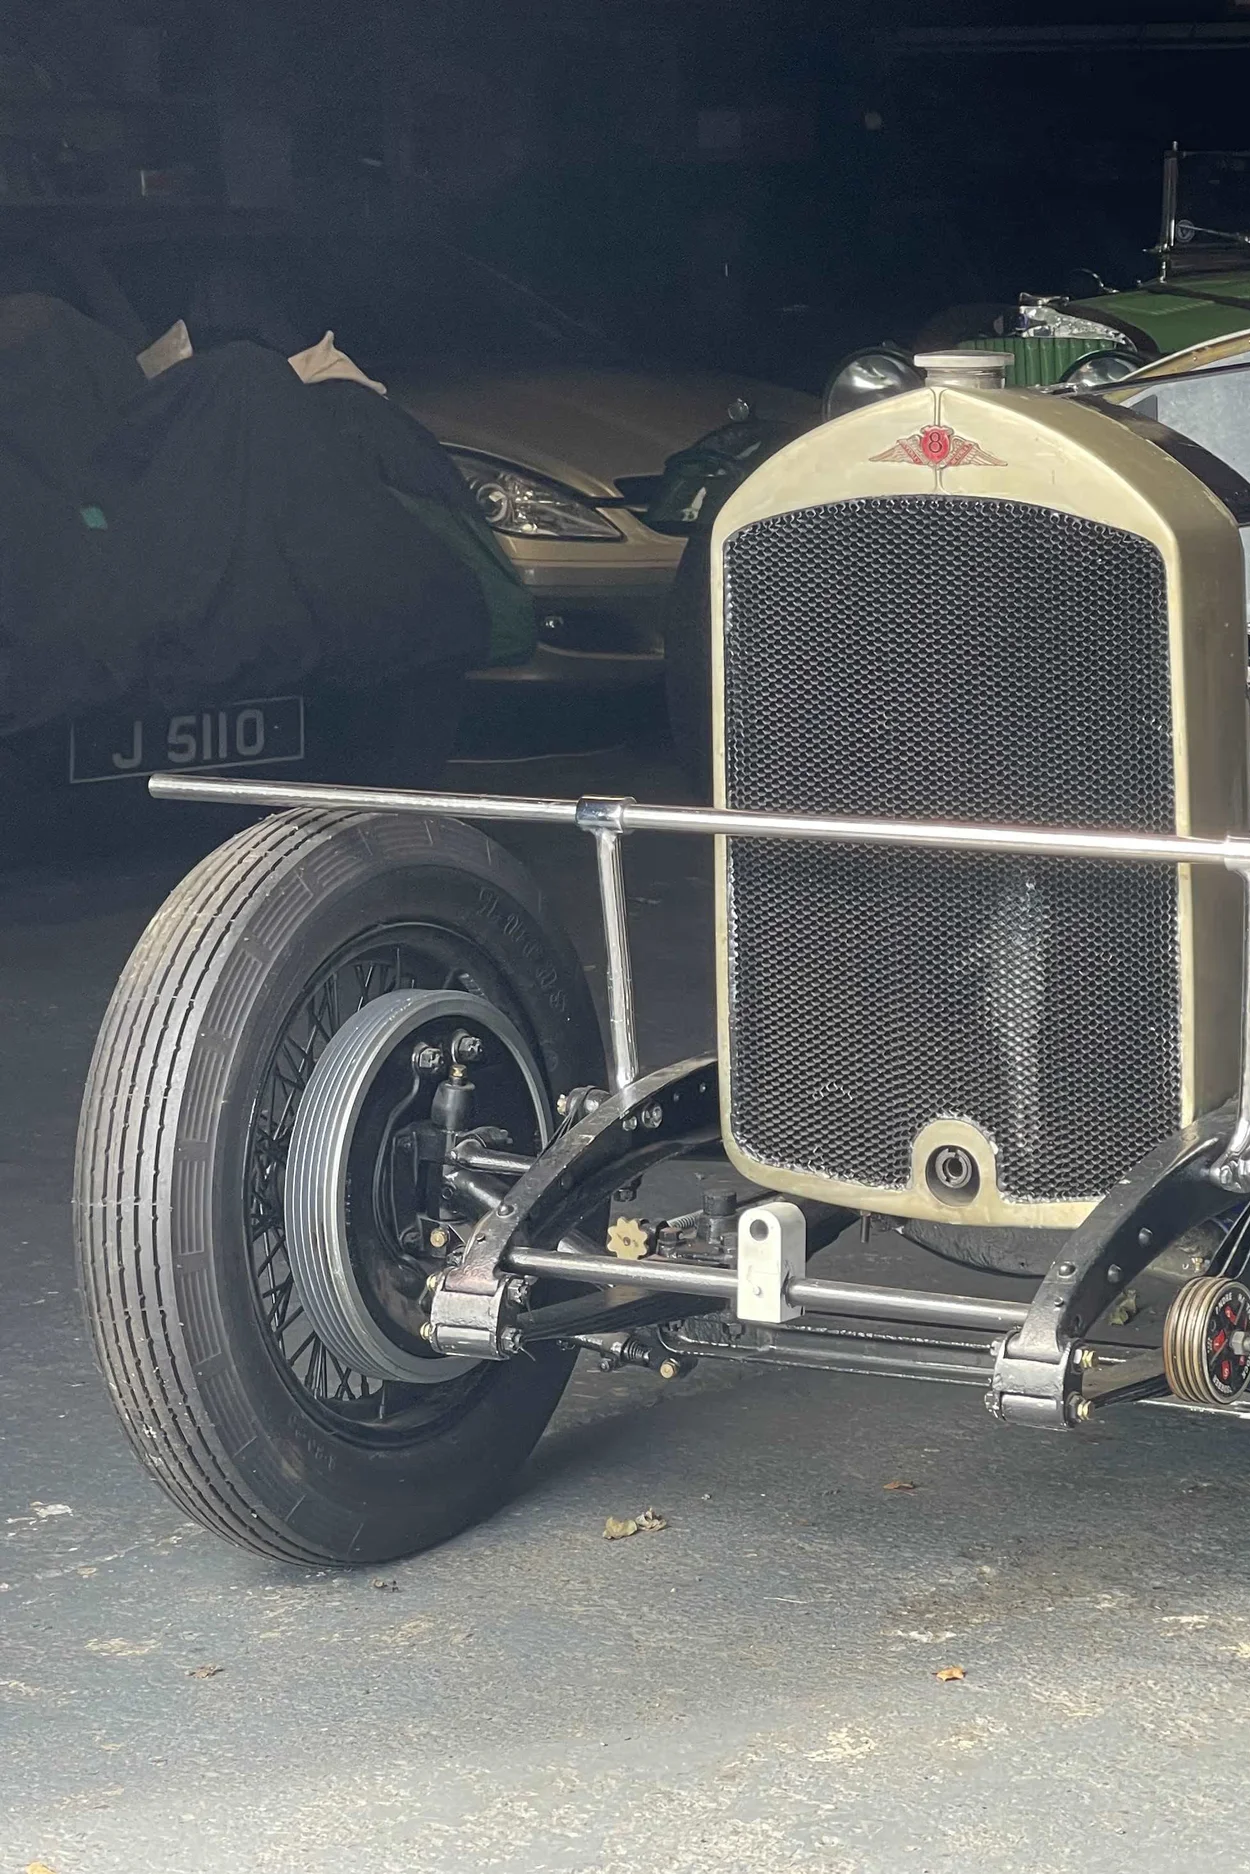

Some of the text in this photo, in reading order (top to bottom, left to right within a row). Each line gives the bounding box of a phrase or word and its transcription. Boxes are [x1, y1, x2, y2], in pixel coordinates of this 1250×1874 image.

[929, 432, 942, 453] 8
[112, 708, 265, 769] J 5110
